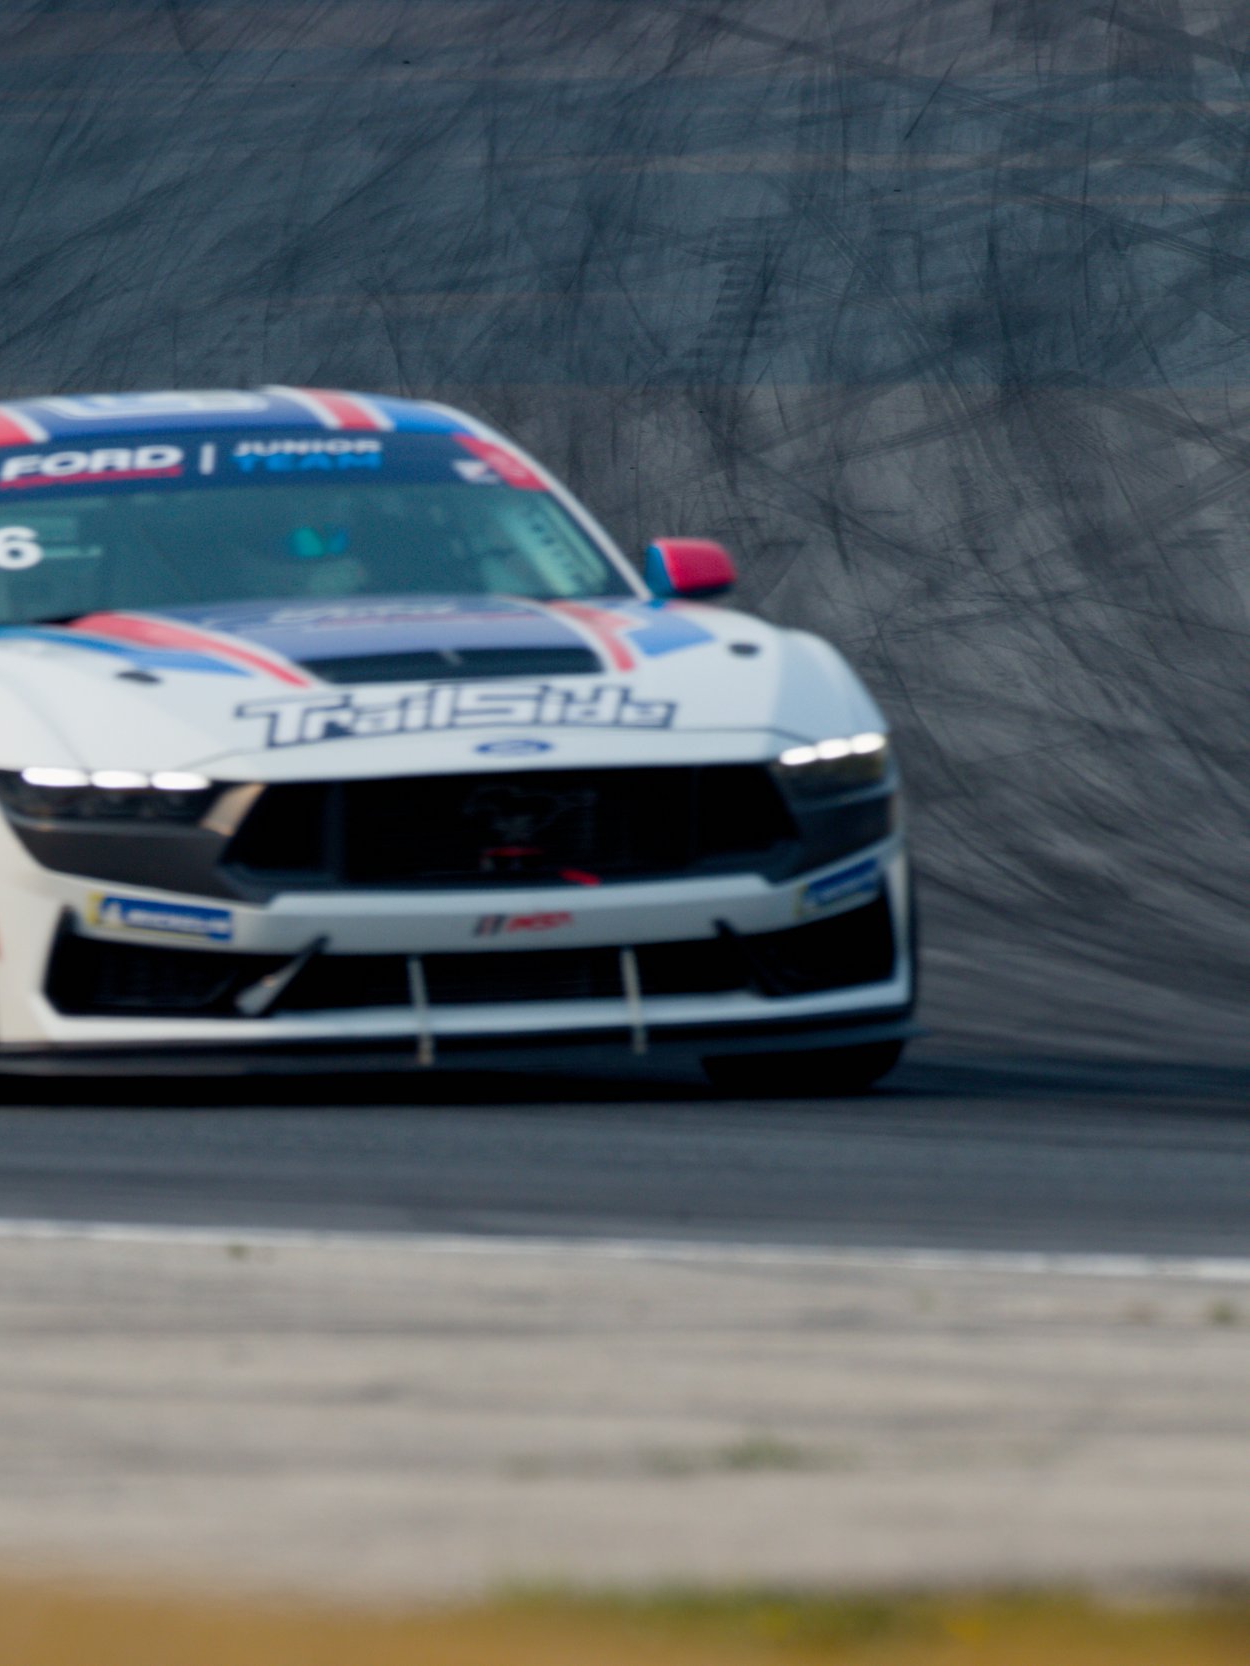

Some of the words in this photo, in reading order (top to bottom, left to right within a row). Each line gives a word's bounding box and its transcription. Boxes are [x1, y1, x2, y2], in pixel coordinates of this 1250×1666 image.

[234, 438, 382, 457] JUNIOR
[0, 444, 183, 482] FORD
[234, 453, 382, 473] TEAM
[234, 684, 678, 749] TrailSide
